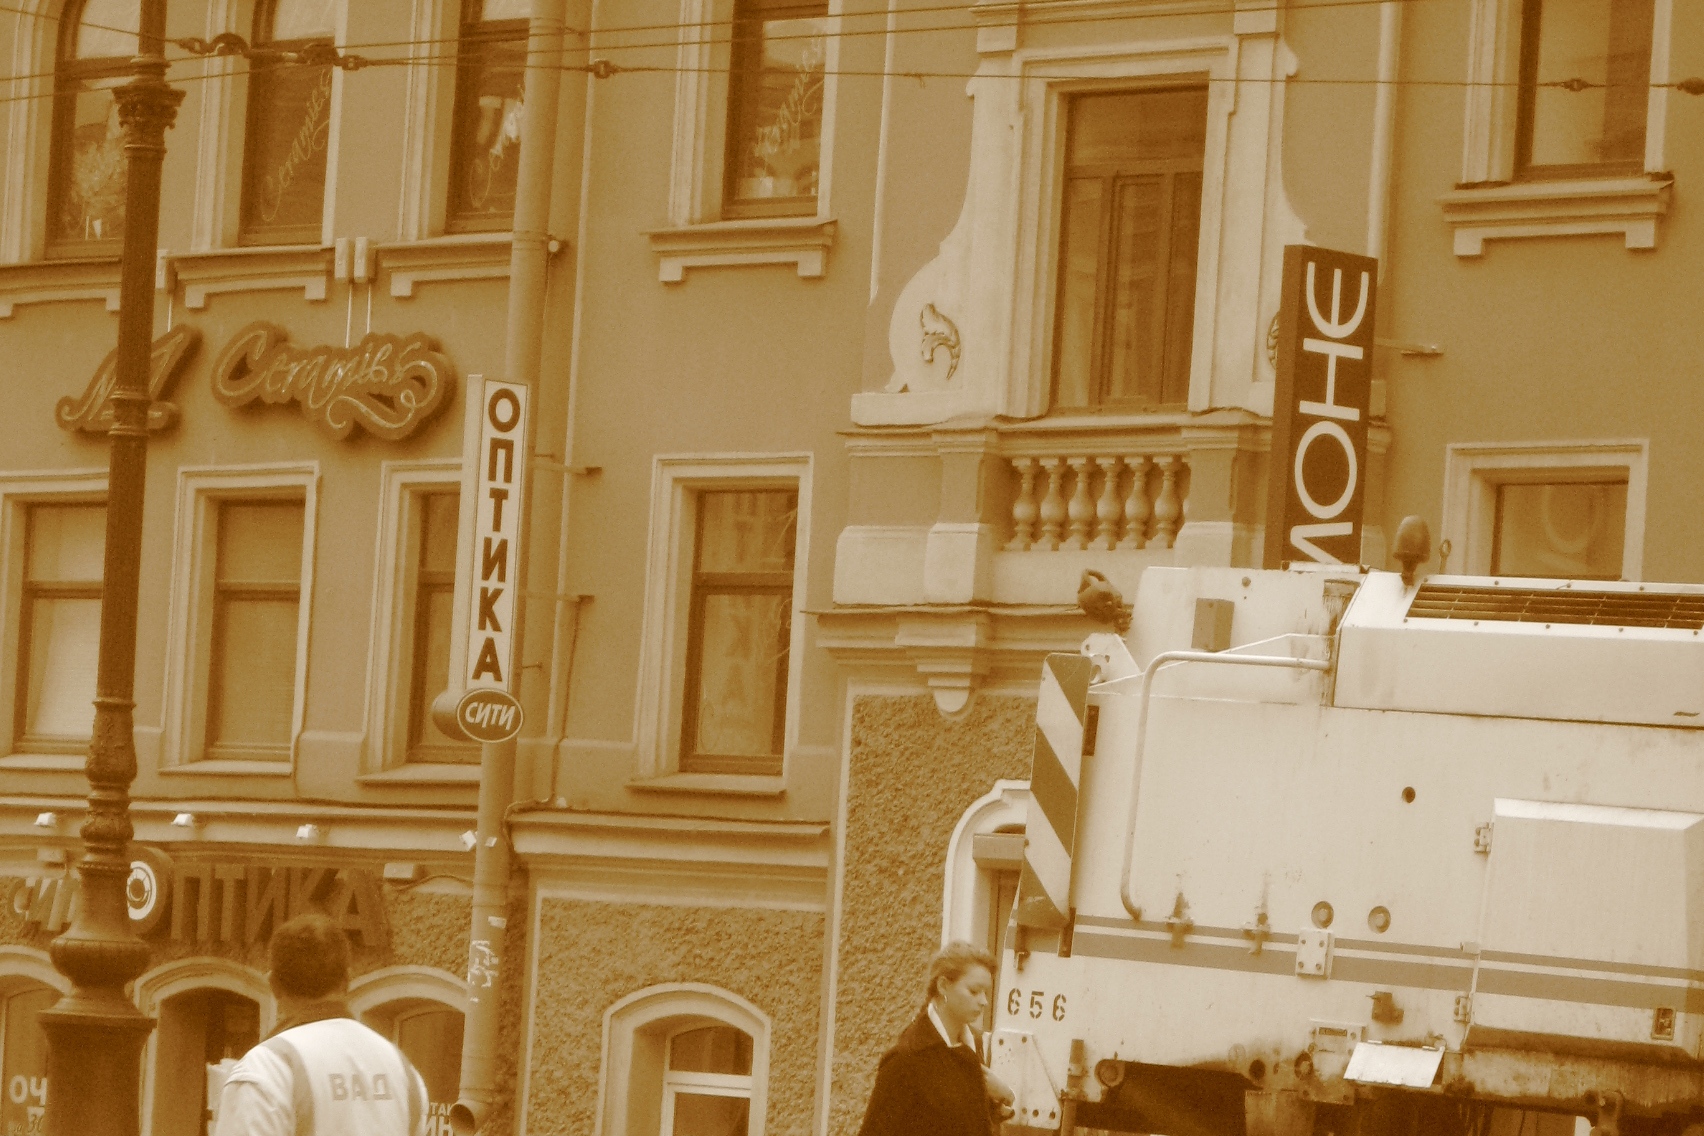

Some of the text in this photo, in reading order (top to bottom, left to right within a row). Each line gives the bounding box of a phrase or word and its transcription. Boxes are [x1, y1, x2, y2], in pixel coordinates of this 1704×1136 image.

[471, 387, 521, 682] ОПТИКА
[465, 701, 516, 731] СИТИ
[1007, 988, 1067, 1021] 656
[328, 1073, 392, 1101] ВАД
